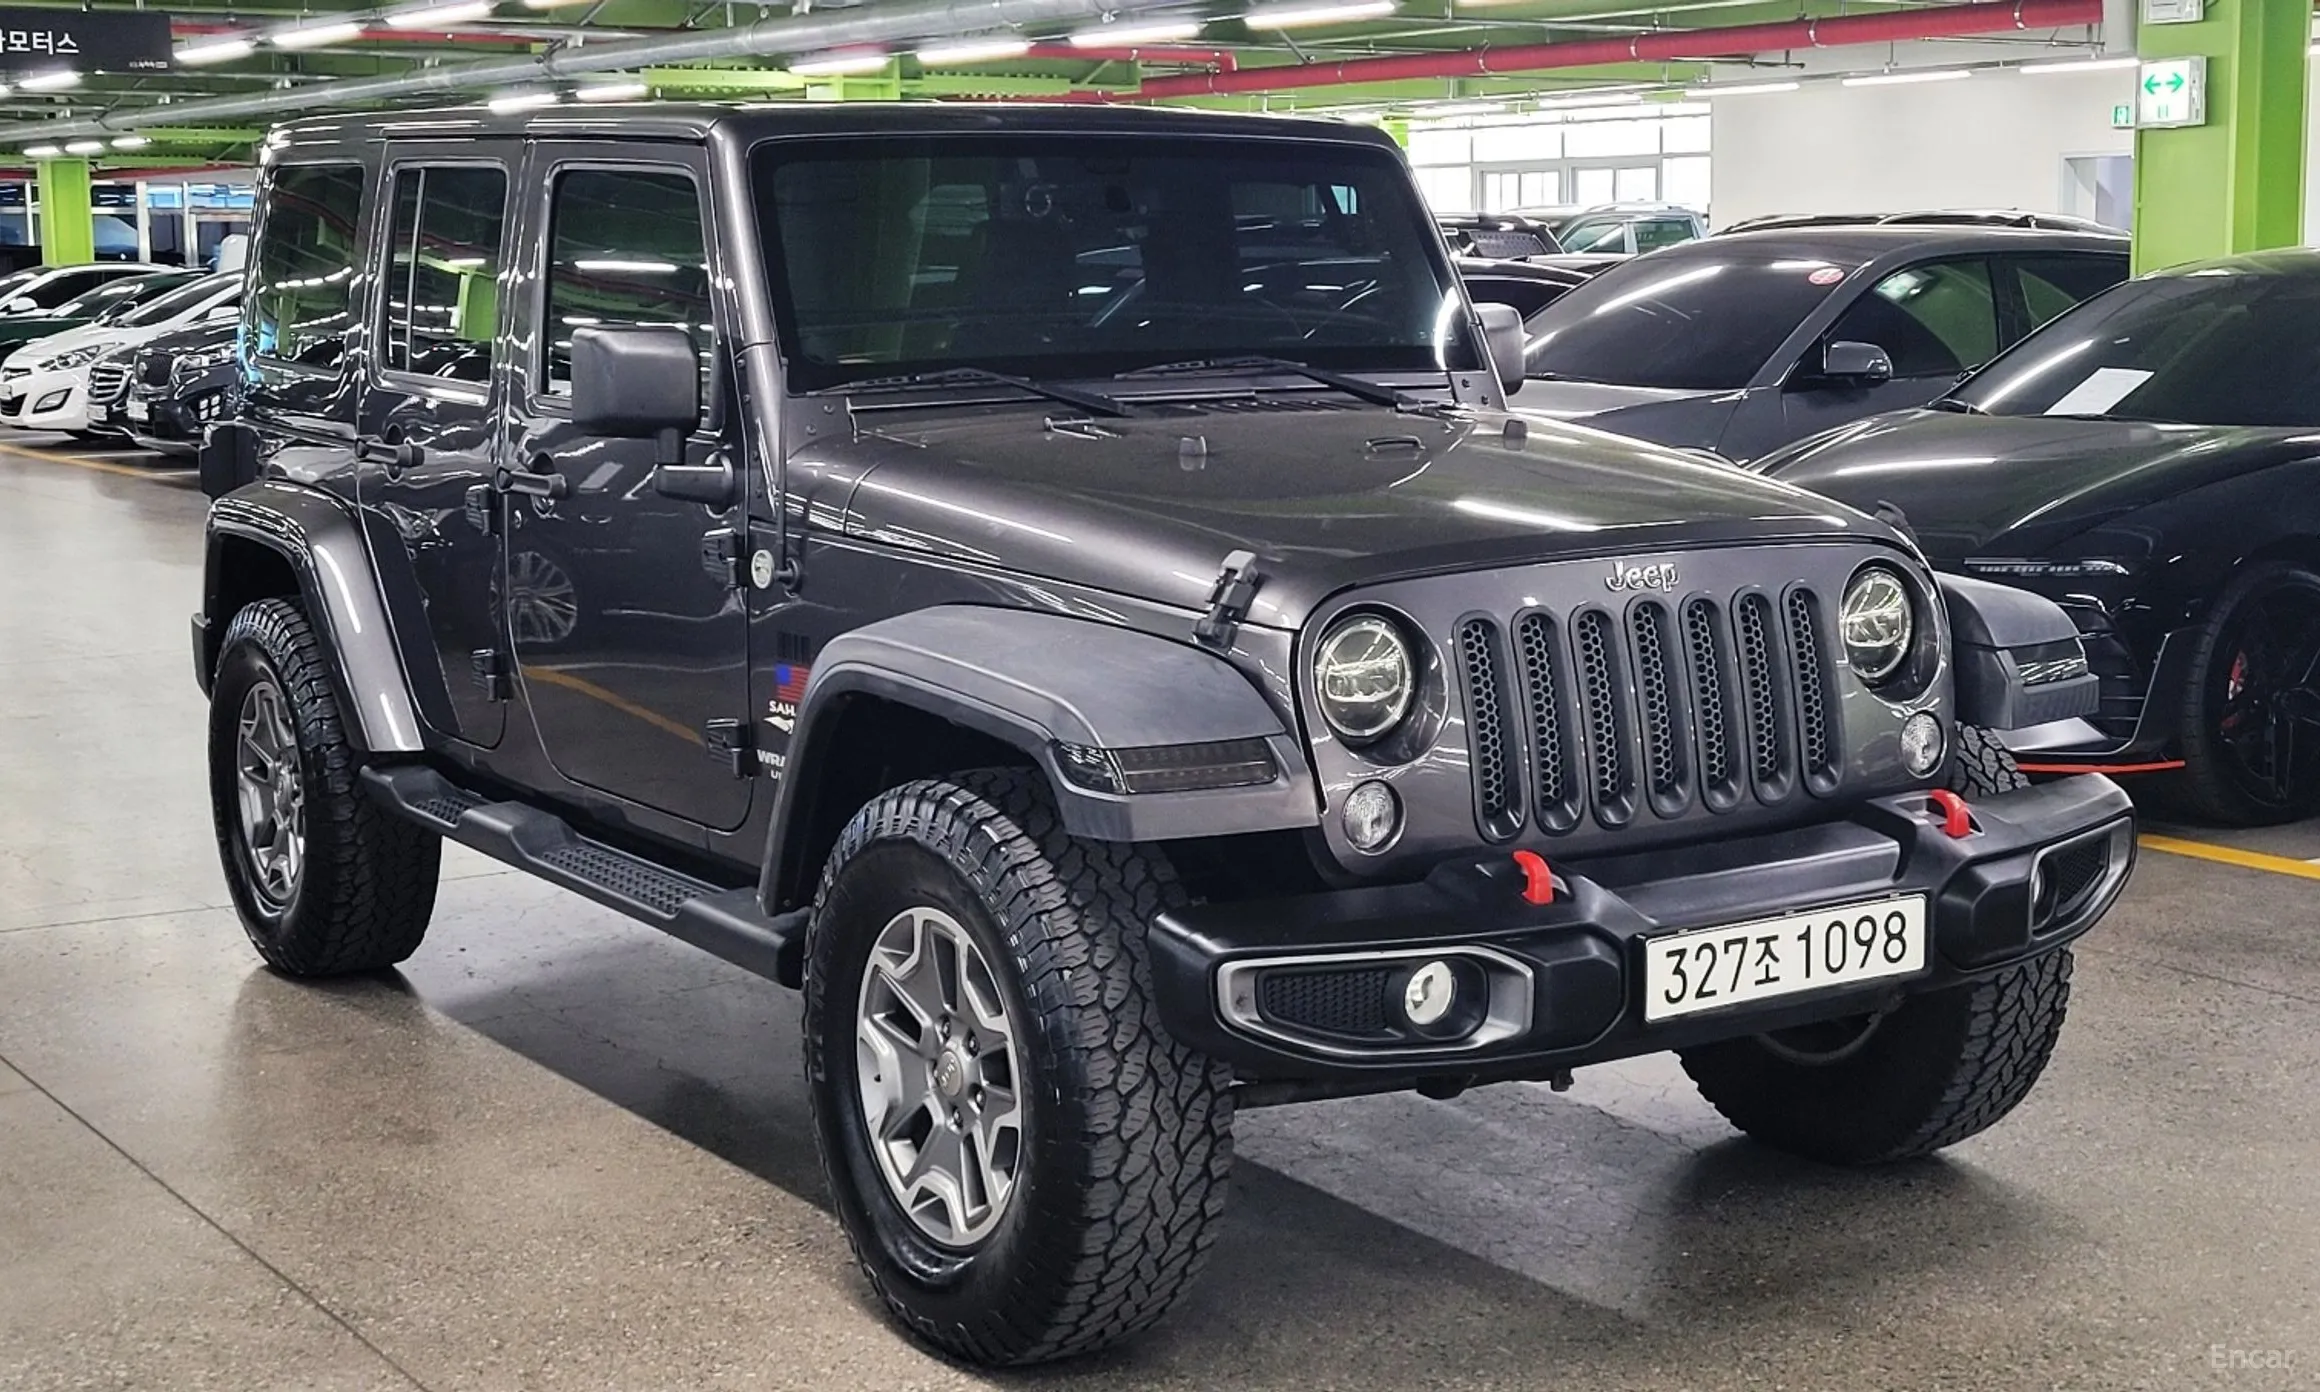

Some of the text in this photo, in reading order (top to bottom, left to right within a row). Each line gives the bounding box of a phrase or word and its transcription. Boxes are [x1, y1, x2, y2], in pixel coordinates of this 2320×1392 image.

[1604, 560, 1679, 593] Jeep
[768, 700, 797, 717] SAH
[1664, 910, 1907, 1005] 327조 1098
